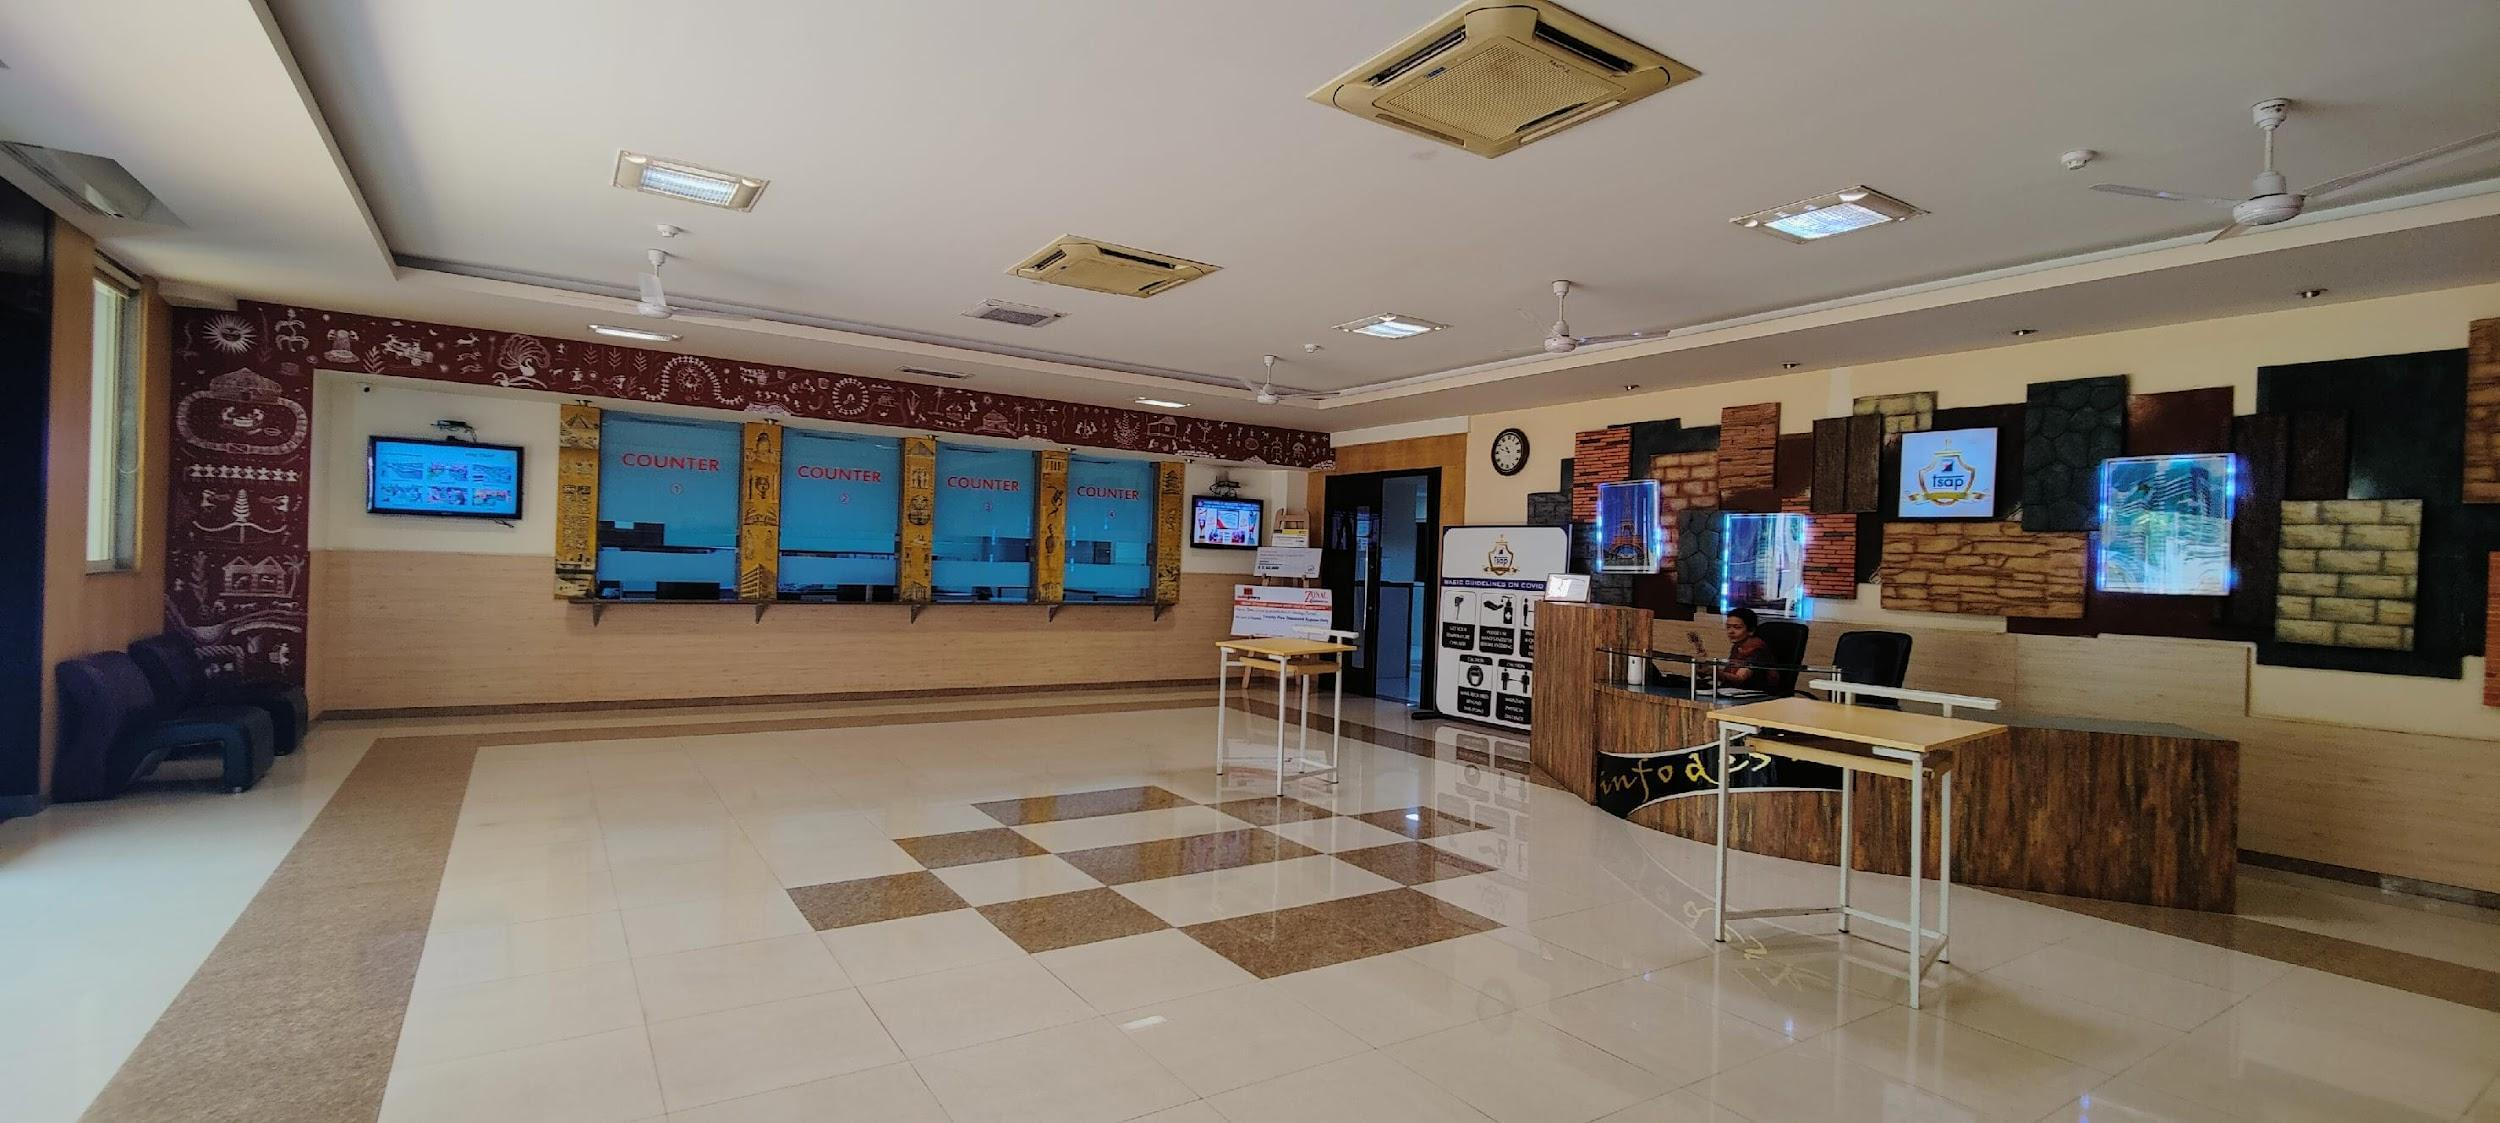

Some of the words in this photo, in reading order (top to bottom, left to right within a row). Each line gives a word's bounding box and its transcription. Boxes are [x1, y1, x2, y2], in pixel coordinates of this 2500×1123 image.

[622, 453, 720, 473] COUNTER
[797, 465, 882, 483] COUNTER
[947, 476, 1020, 492] COUNTER
[1076, 486, 1140, 501] COUNTER
[1465, 580, 1506, 588] GUIDELINES
